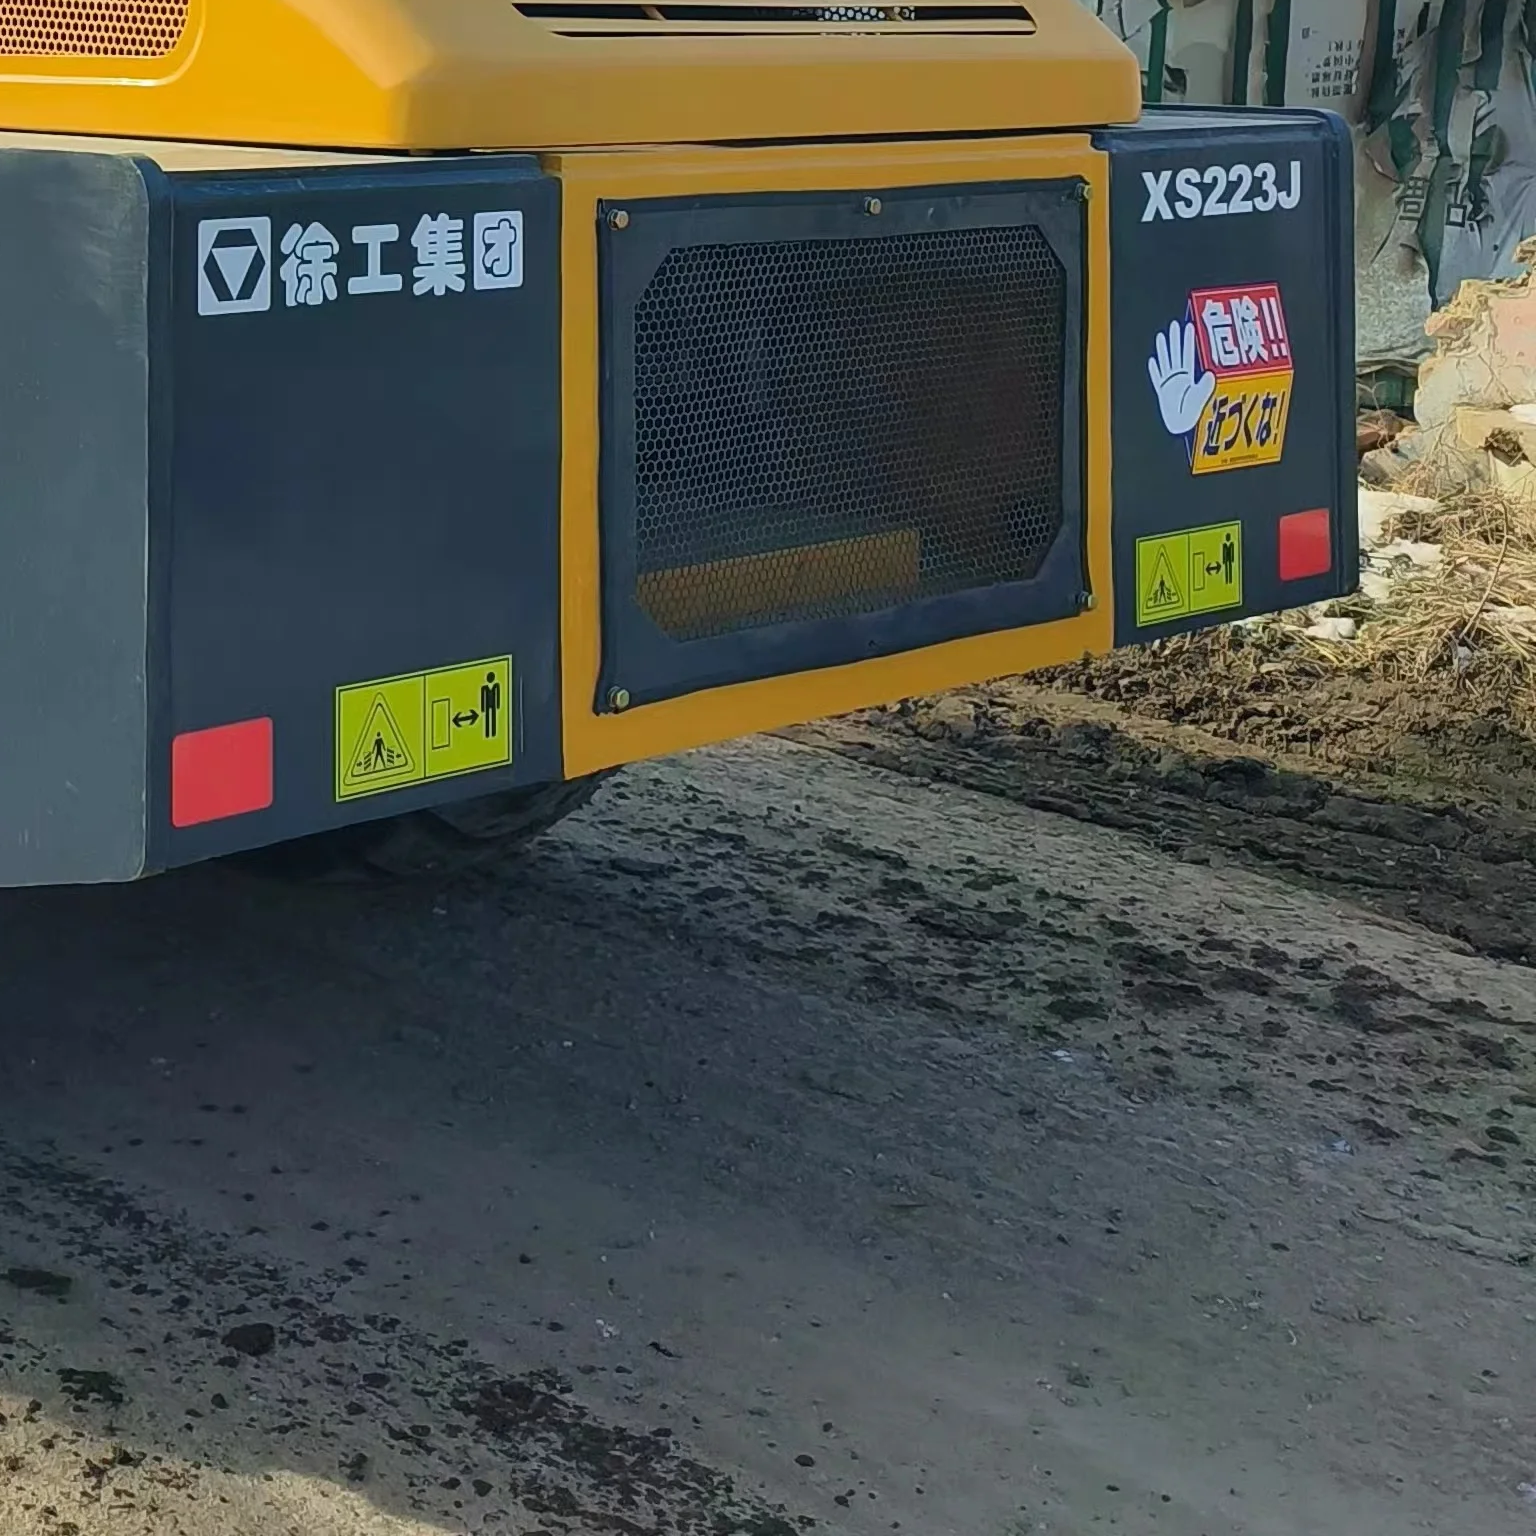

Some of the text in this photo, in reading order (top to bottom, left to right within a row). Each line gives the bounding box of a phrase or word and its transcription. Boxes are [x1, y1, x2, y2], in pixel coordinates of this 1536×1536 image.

[1141, 160, 1301, 222] XS223J
[279, 210, 524, 307] 徐工集团
